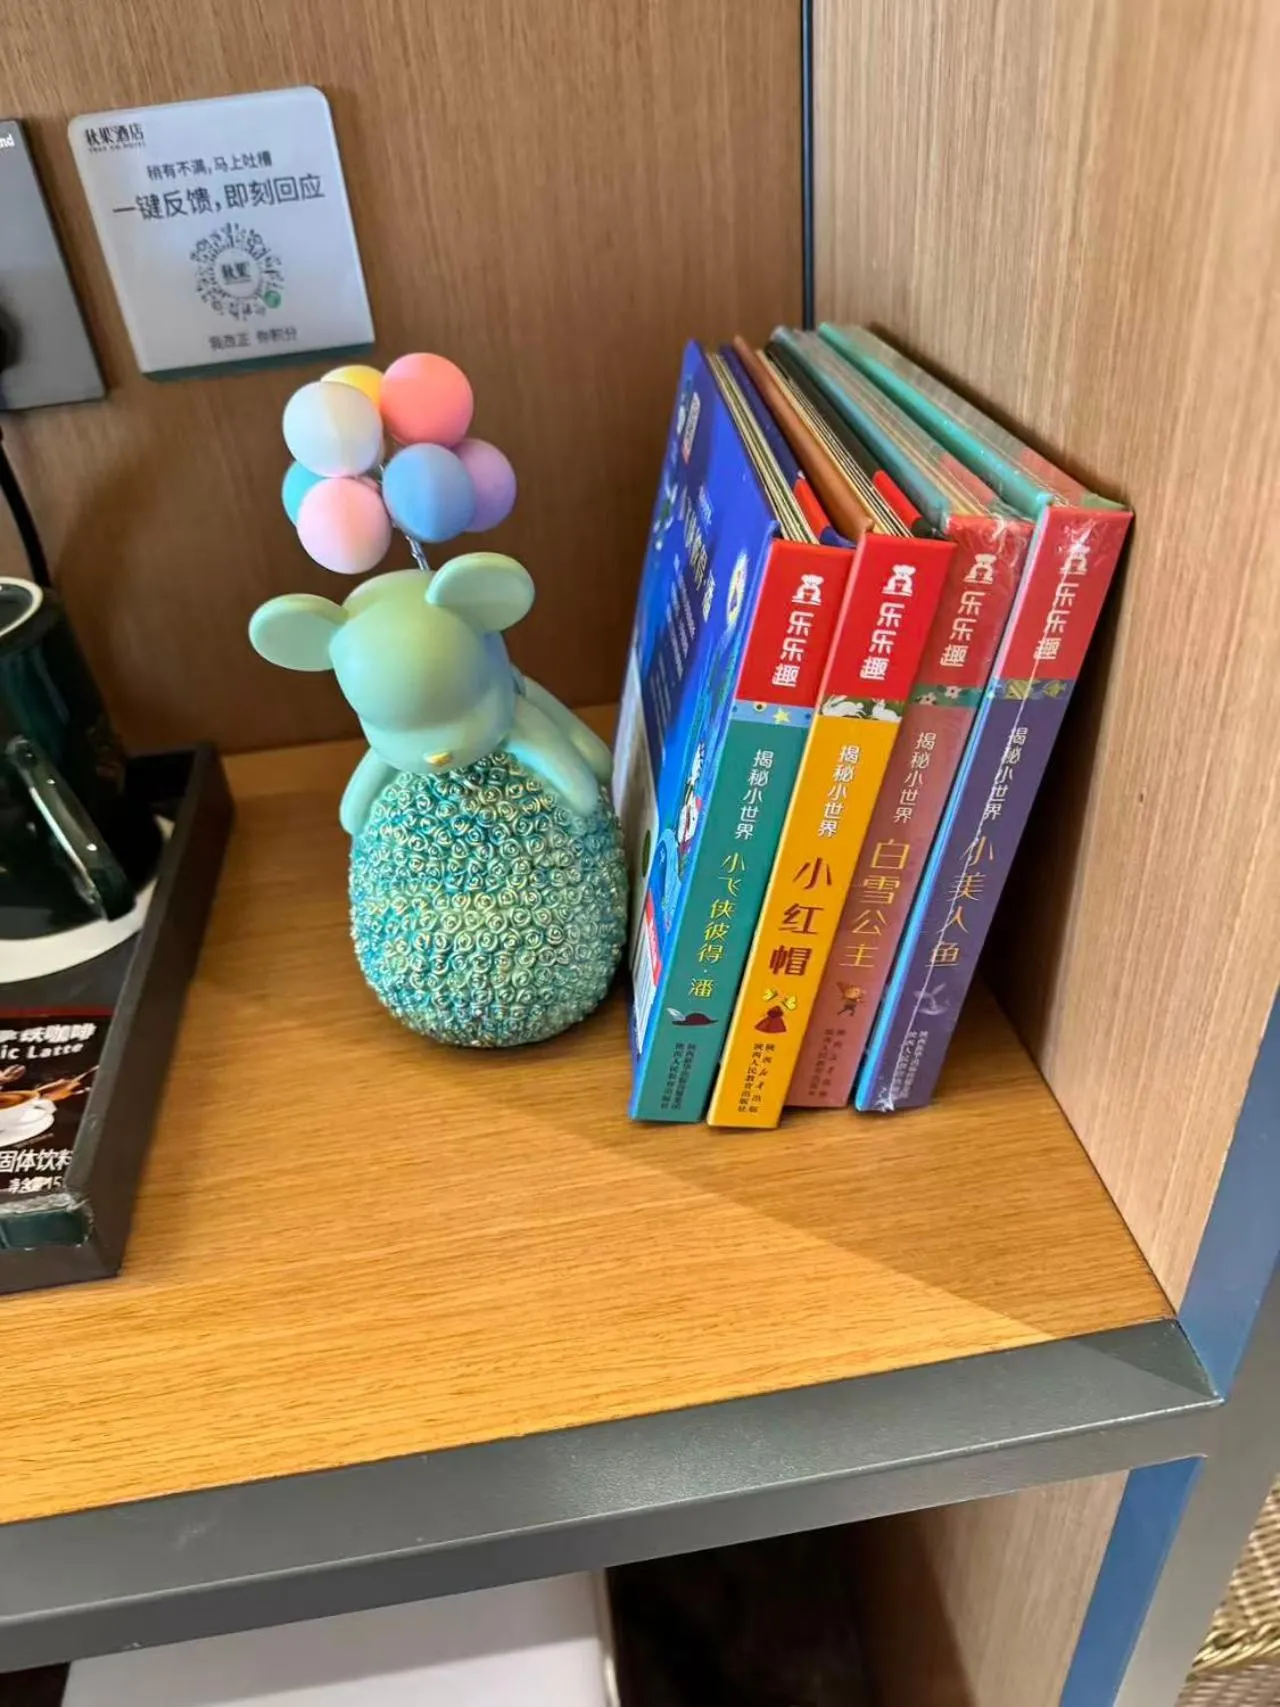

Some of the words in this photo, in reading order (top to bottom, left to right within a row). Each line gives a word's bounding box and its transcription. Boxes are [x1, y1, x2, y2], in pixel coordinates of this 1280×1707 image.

[772, 611, 814, 688] 乐乐趣
[860, 602, 905, 681] 乐乐趣
[940, 591, 986, 668] 乐乐趣
[1033, 582, 1080, 661] 乐乐趣
[735, 749, 774, 840] 揭秘小世界
[818, 745, 861, 838] 揭秘小世界
[894, 732, 937, 824] 揭秘小世界
[985, 727, 1029, 821] 揭秘小世界
[769, 857, 832, 977] 小红帽
[840, 838, 910, 968] 白雪公主
[26, 1043, 84, 1060] Latte
